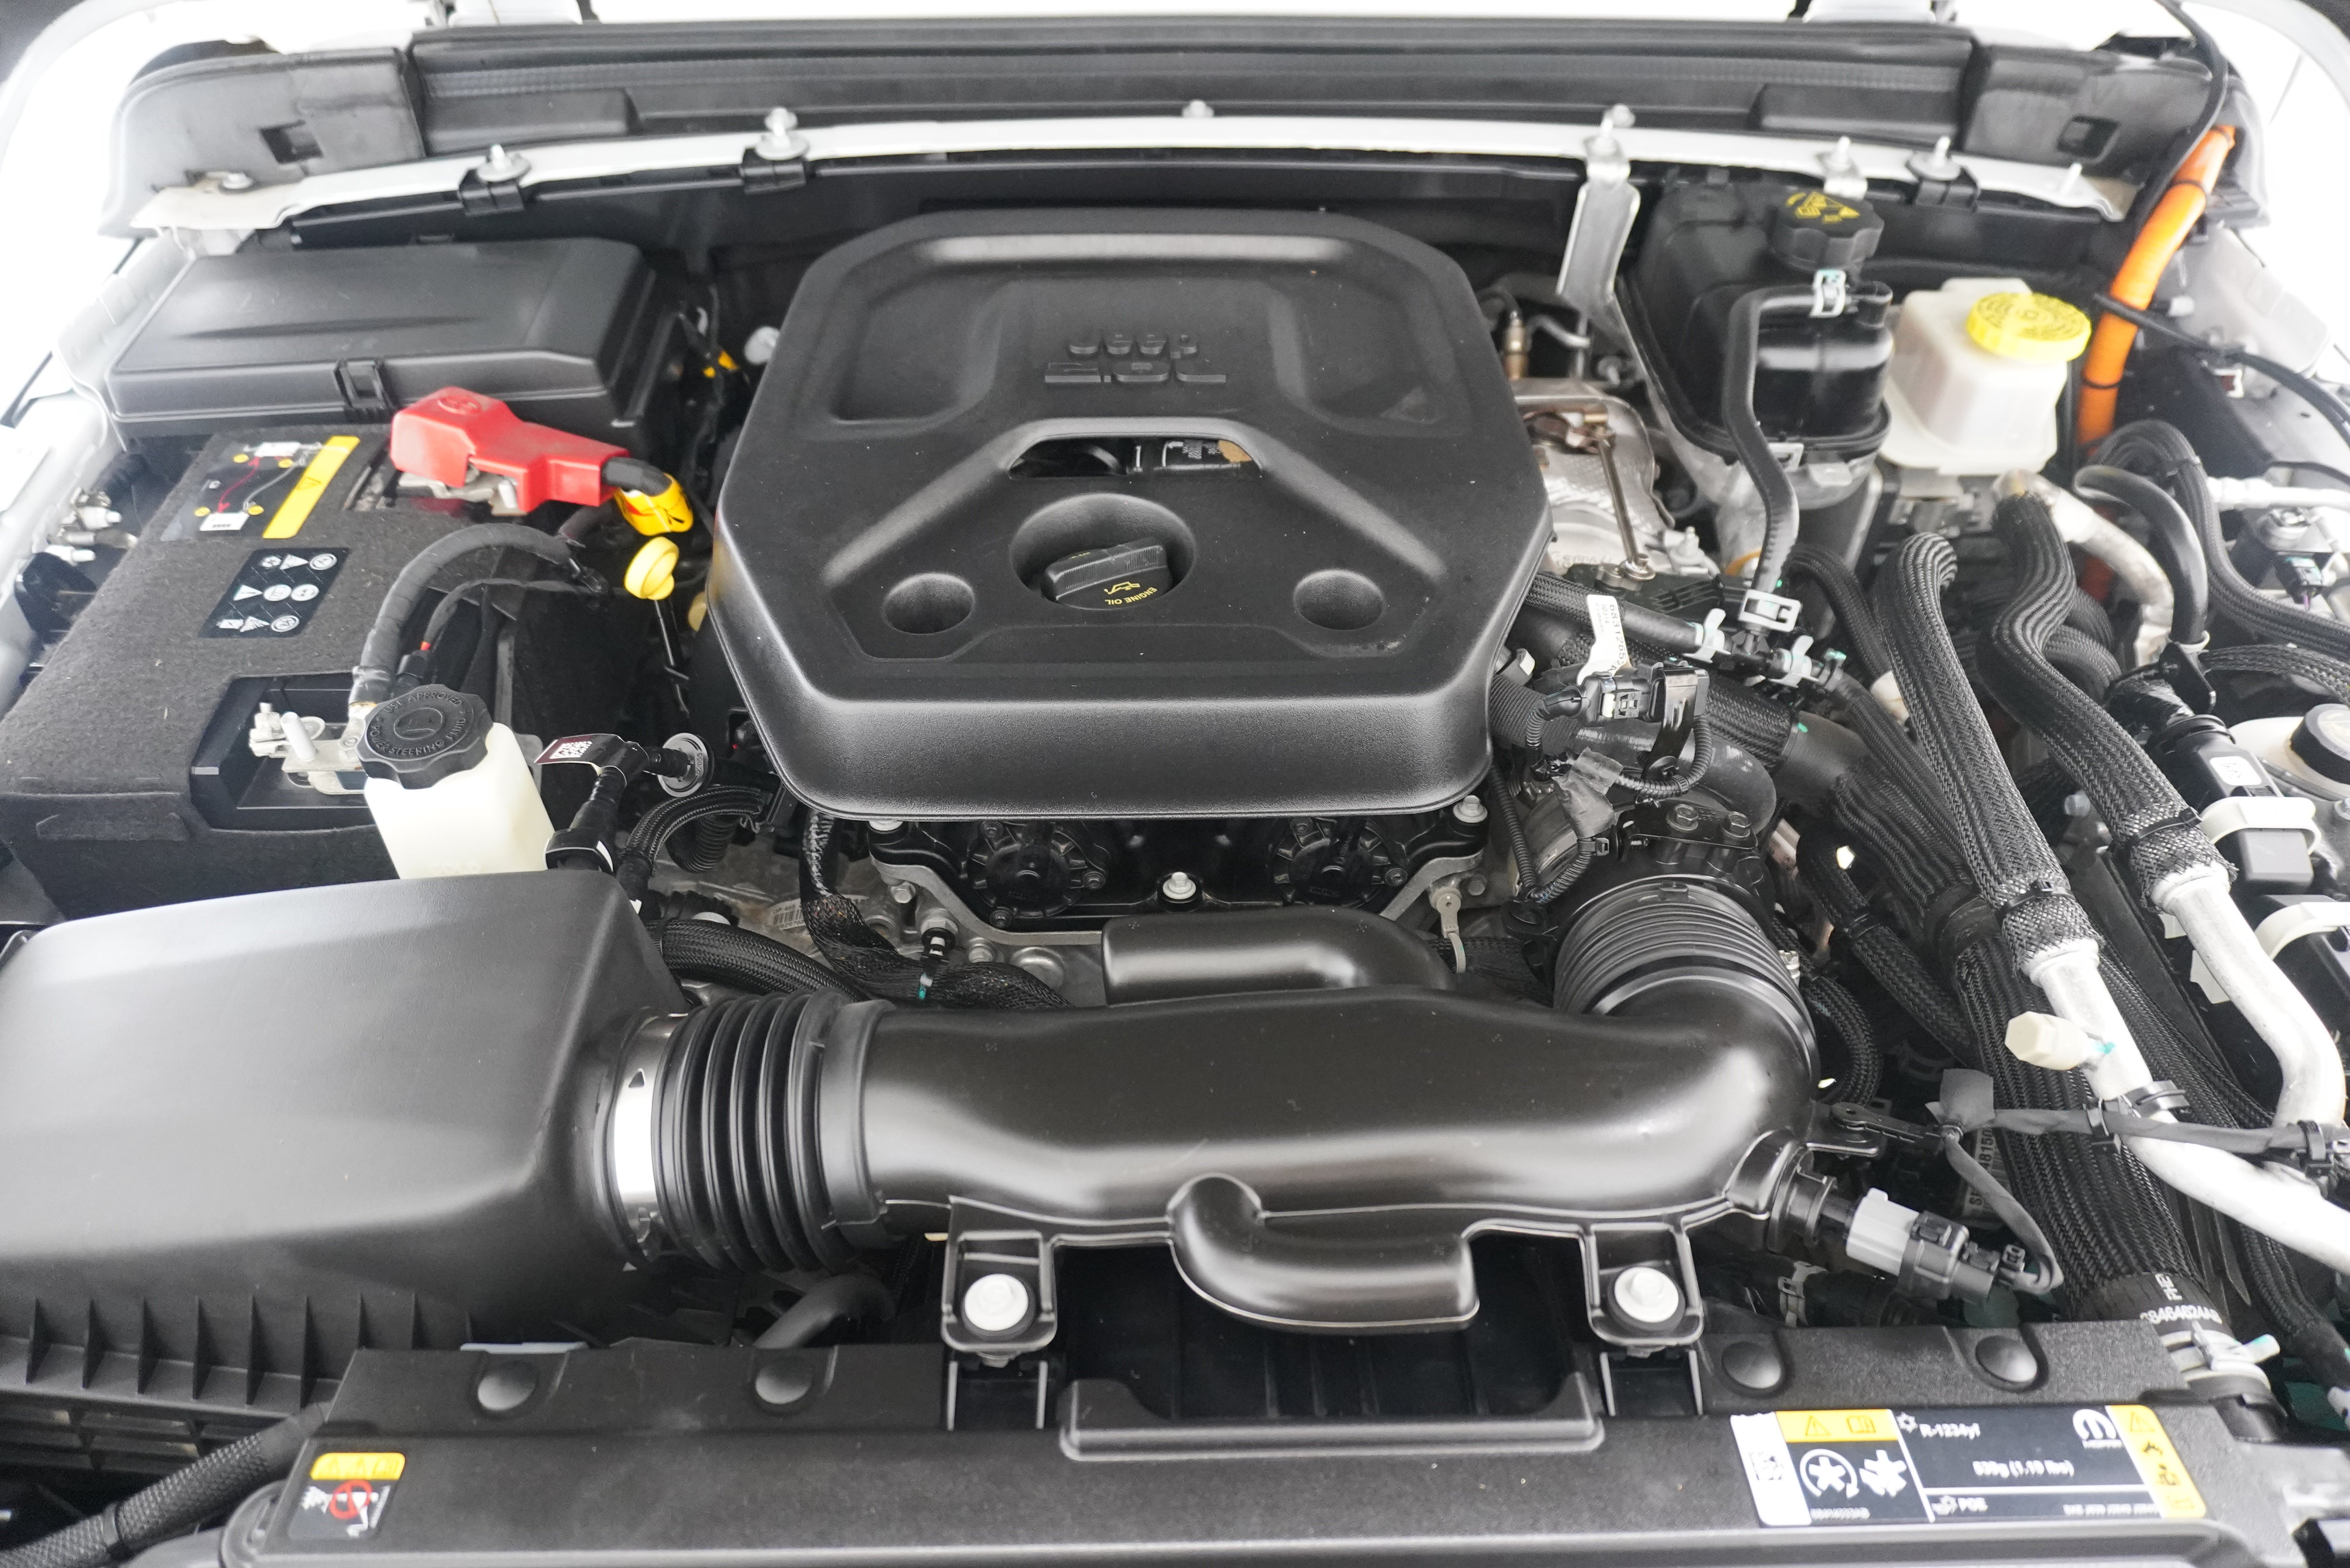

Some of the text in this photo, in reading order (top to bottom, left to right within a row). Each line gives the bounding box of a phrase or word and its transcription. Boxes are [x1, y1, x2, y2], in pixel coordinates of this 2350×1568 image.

[1123, 587, 1158, 603] ENGINE
[407, 691, 463, 706] APPROVED
[370, 718, 467, 756] POWER STEERING FLUID
[1919, 1422, 1981, 1440] R-1234yf
